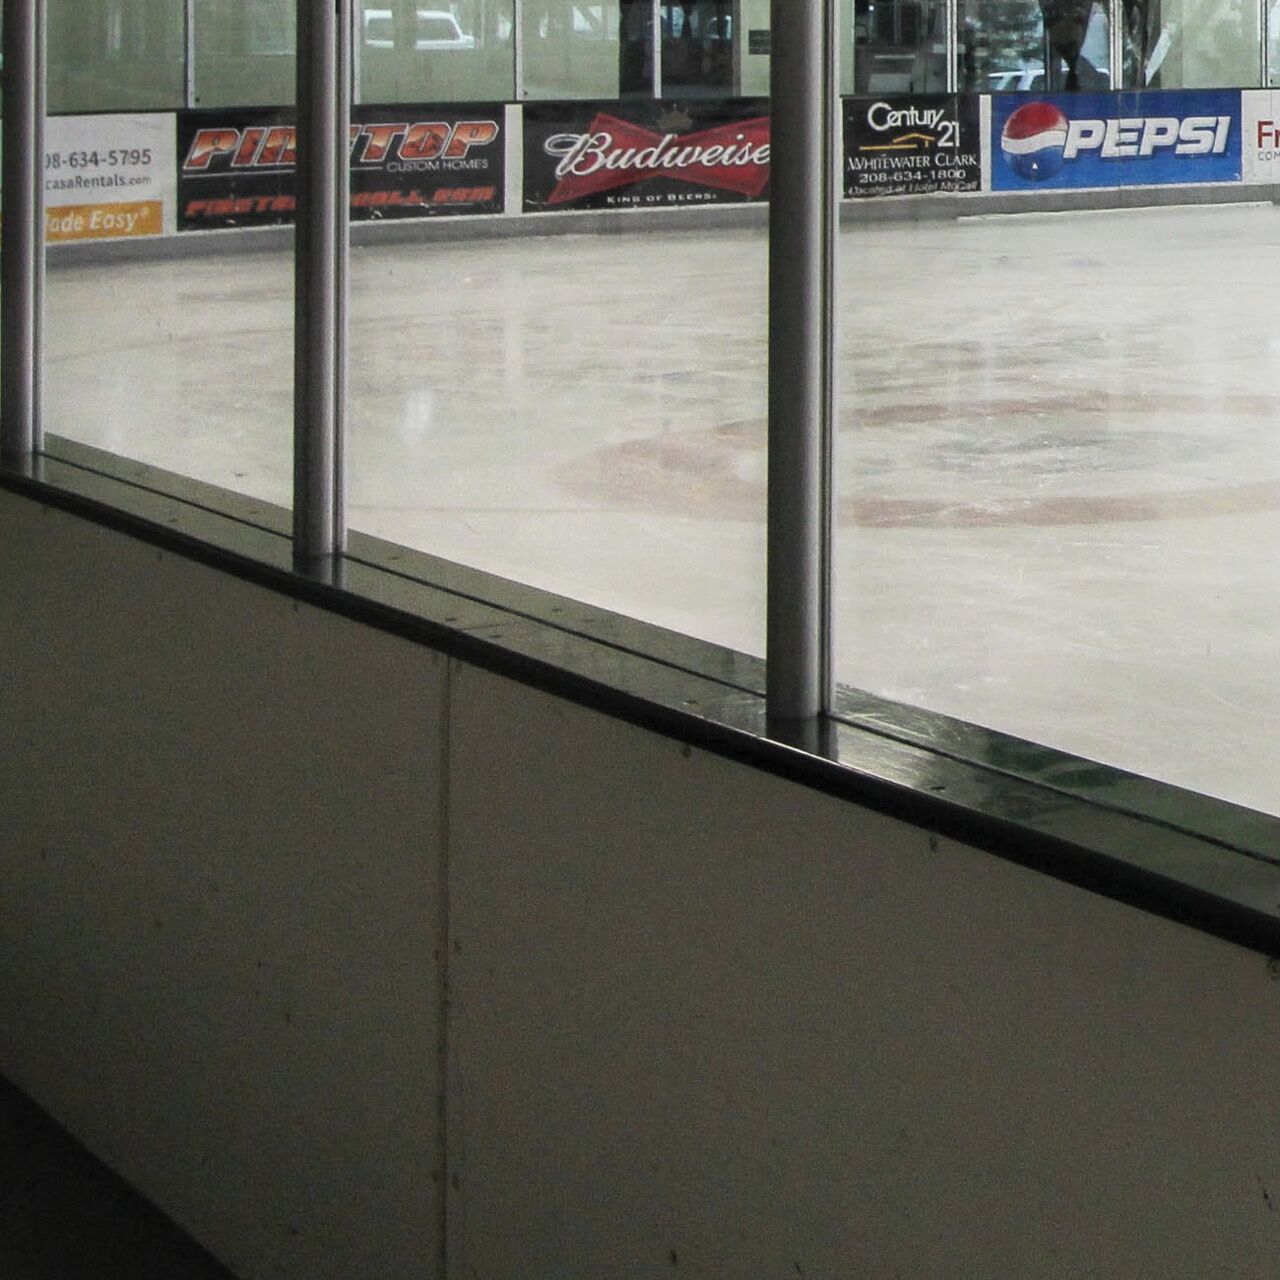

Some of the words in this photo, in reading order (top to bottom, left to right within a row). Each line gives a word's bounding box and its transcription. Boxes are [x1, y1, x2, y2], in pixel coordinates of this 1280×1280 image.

[867, 102, 945, 131] Century
[183, 120, 499, 170] PINTOP
[937, 121, 960, 147] 21
[1063, 116, 1232, 160] PEPSI
[543, 123, 771, 180] Budweise
[848, 156, 931, 170] WHITEWATER
[935, 153, 977, 166] CLARK
[386, 160, 440, 172] CUSTOM
[442, 158, 489, 169] HOMES
[860, 170, 966, 183] 208-634-1800
[46, 173, 152, 190] casaRentals.com
[46, 212, 83, 233] ade
